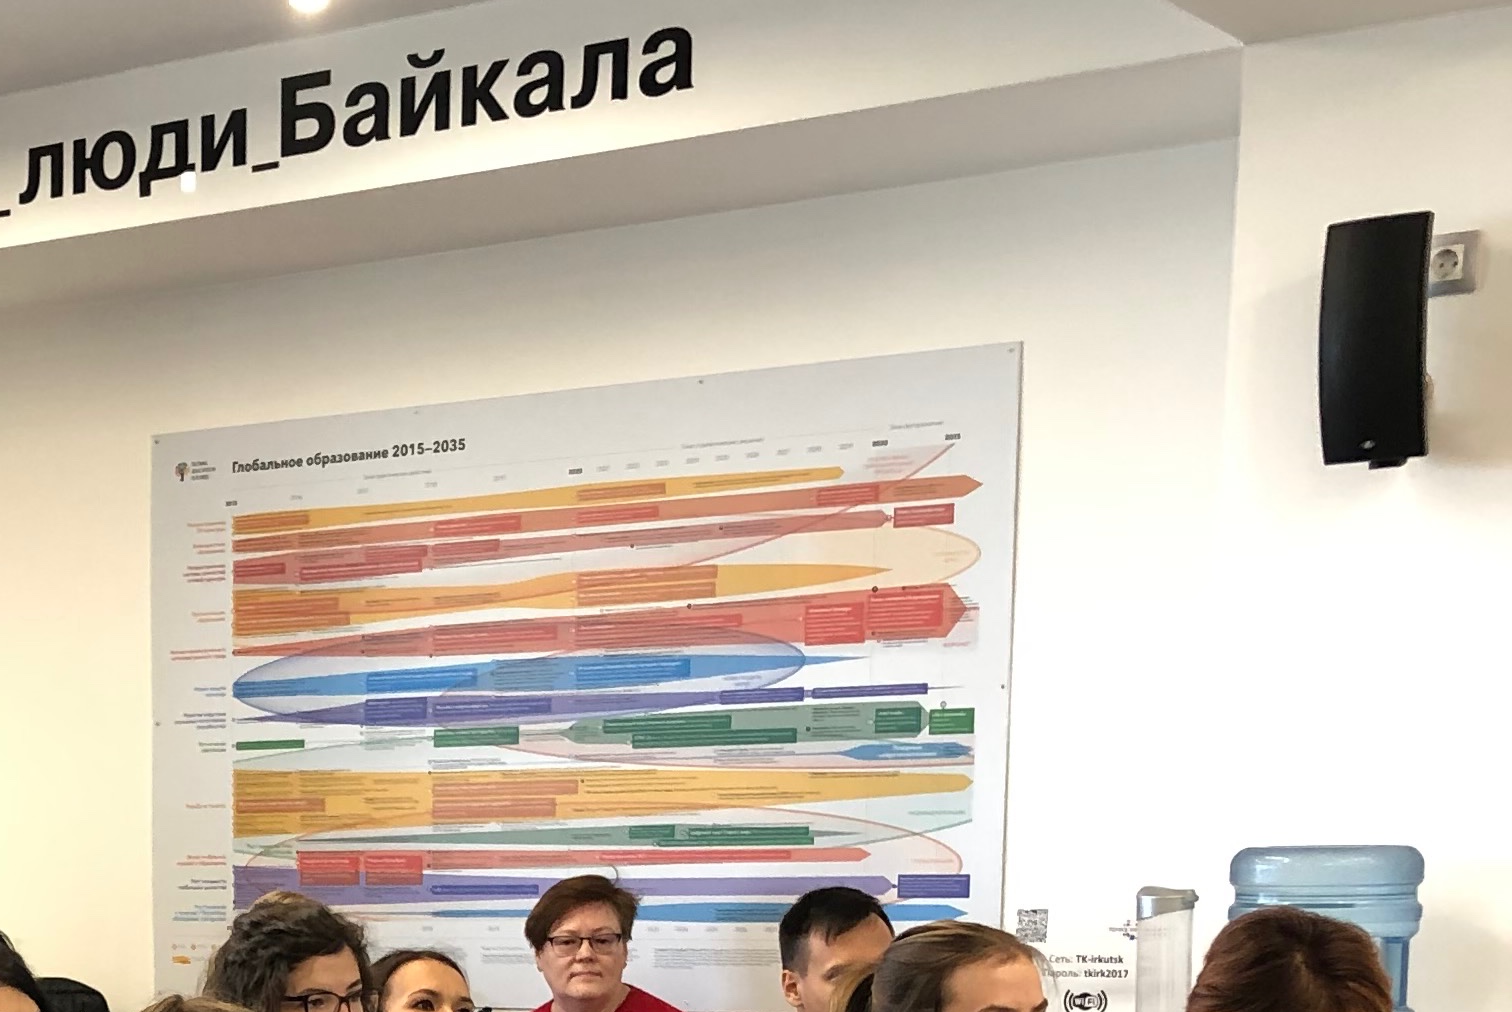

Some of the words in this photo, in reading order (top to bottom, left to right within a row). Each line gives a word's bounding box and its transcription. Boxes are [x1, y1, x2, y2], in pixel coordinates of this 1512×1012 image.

[232, 456, 303, 473] Глобальное
[306, 448, 389, 468] образование
[1076, 954, 1124, 964] TK-irkutsk
[1084, 968, 1129, 978] tkirk2017
